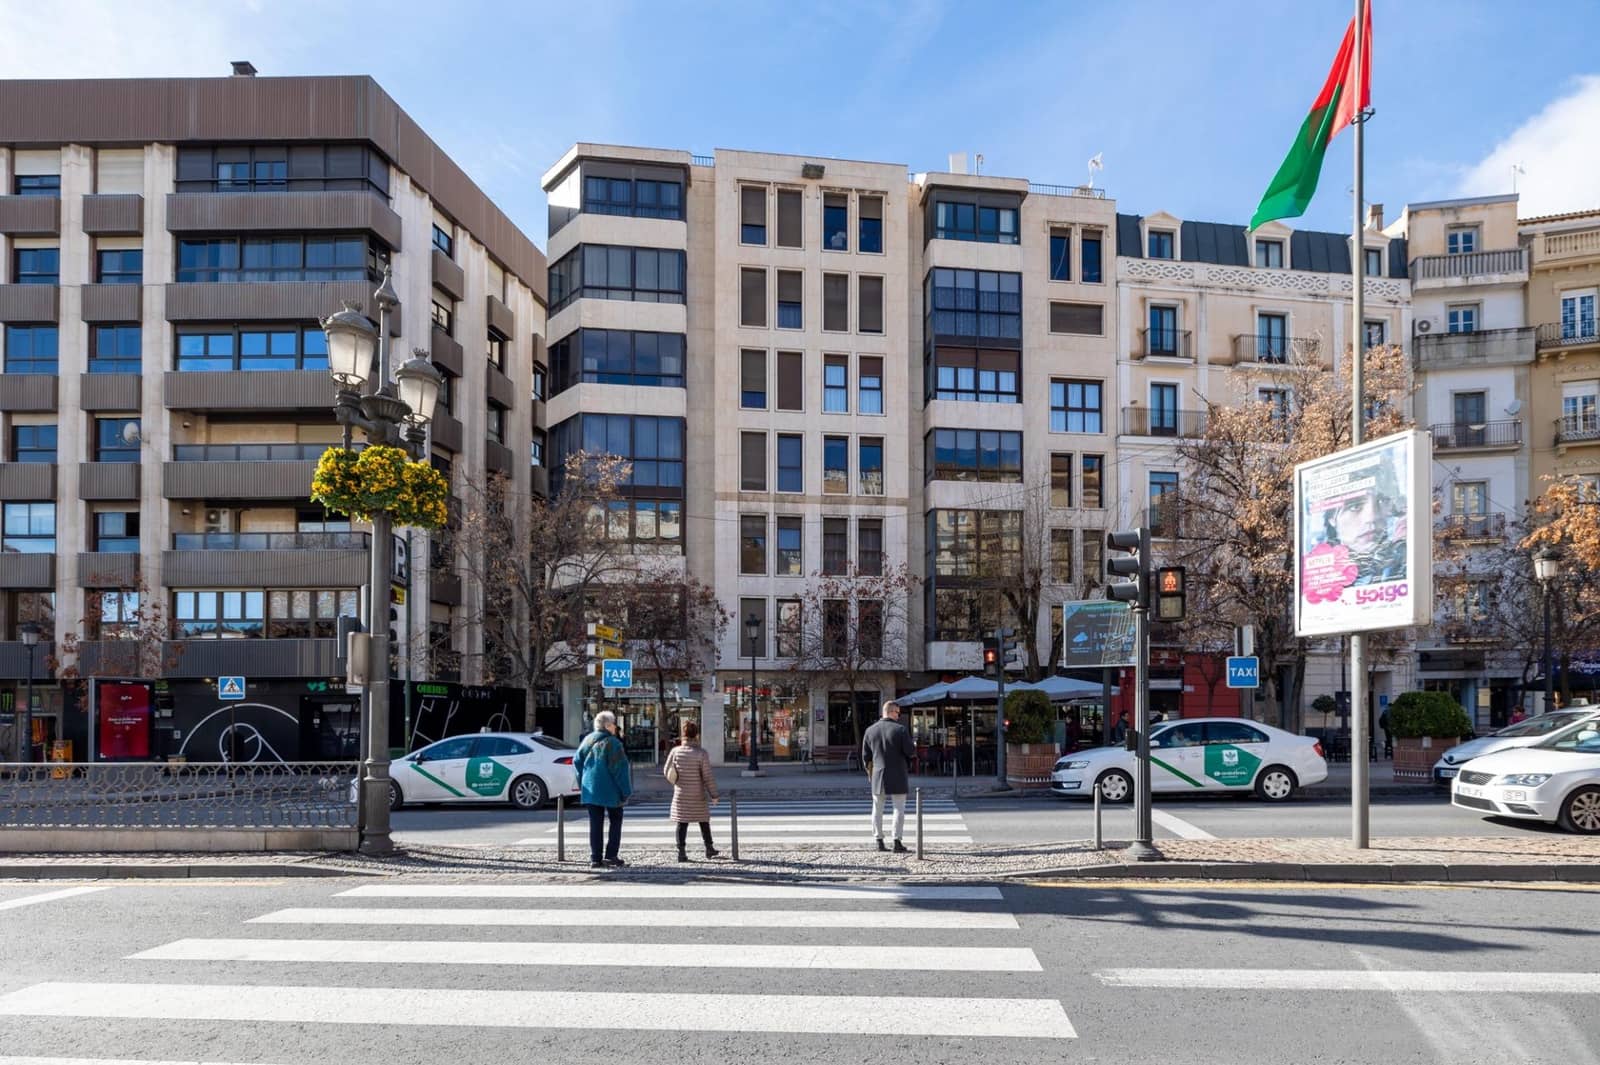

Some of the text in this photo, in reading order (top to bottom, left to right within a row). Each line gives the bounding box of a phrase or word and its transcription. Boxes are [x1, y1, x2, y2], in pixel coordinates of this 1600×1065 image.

[1356, 583, 1408, 605] yoigo
[605, 669, 630, 678] TAXI
[1230, 667, 1257, 677] TAXI
